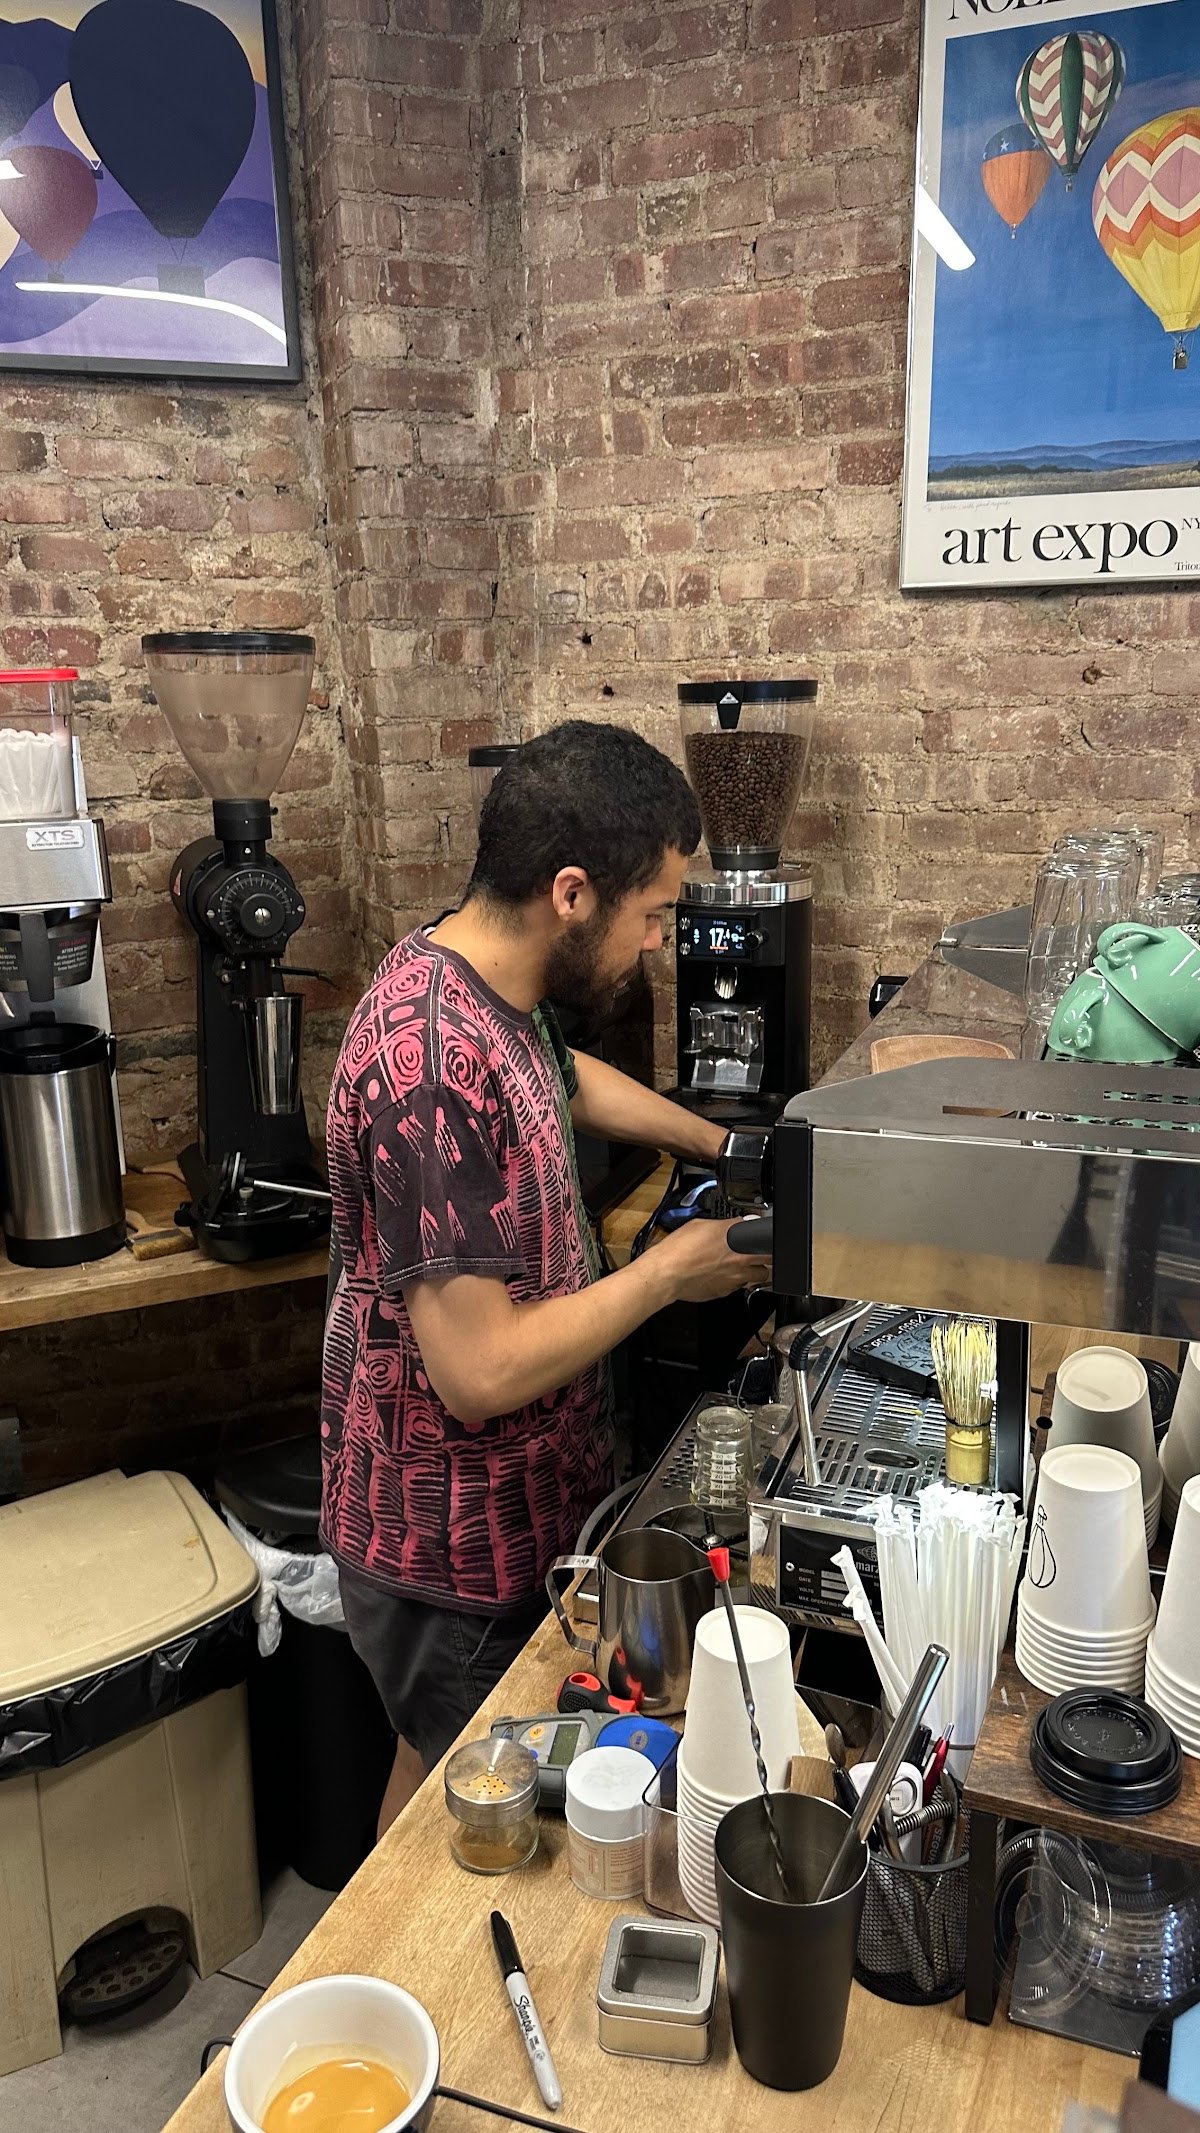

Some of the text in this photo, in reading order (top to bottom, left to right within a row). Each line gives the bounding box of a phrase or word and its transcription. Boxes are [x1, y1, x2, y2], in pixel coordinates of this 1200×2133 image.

[942, 517, 1022, 565] art
[1032, 519, 1179, 573] expo
[34, 829, 76, 843] XTS
[798, 1567, 816, 1575] MODEL
[513, 1994, 536, 2039] Sharpie
